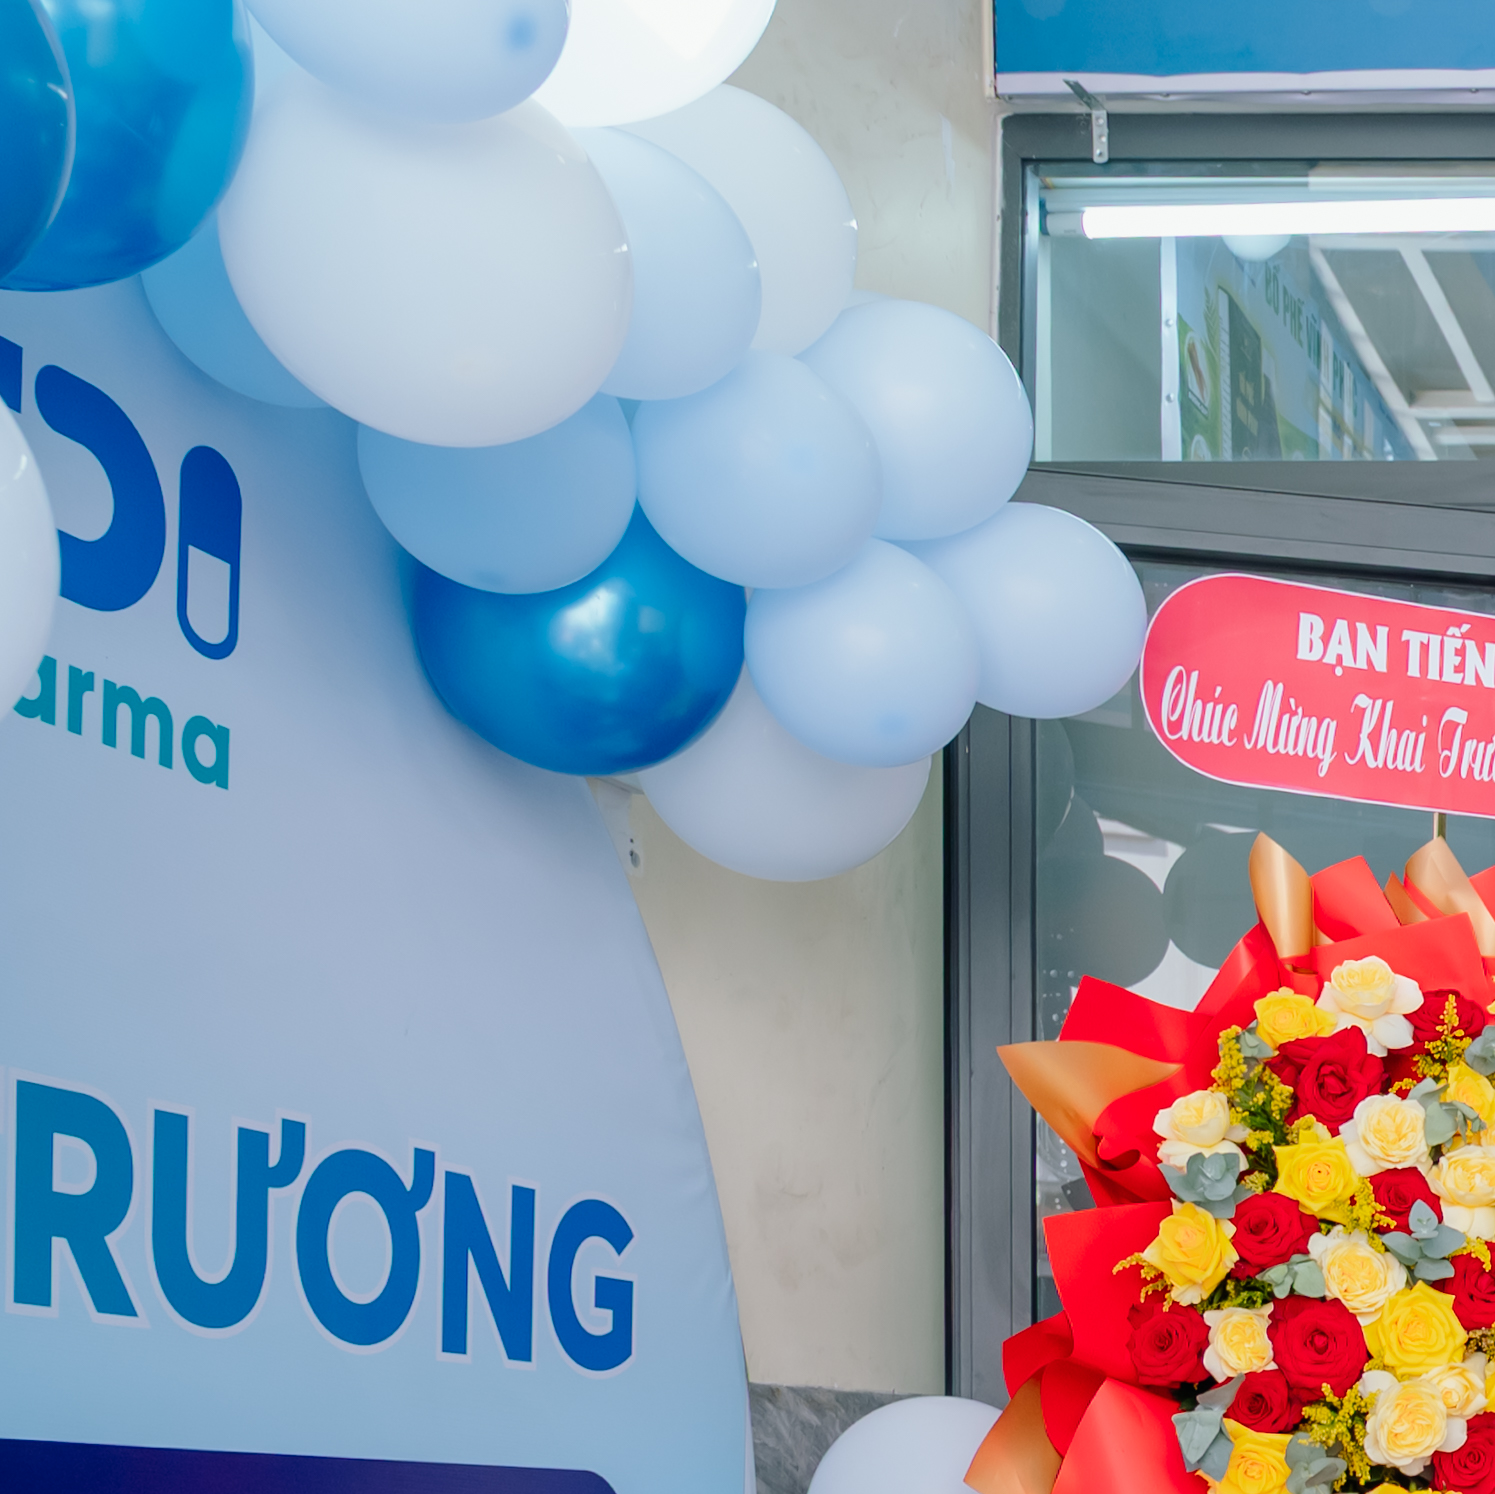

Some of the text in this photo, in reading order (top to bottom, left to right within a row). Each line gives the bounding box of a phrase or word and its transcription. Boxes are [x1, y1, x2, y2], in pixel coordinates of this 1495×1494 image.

[1297, 612, 1388, 677] BẠN
[12, 653, 231, 790] arma
[1160, 664, 1238, 748] Chúc
[1244, 680, 1338, 778] Mừng
[1344, 694, 1428, 774] Khai
[12, 1077, 636, 1373] RƯƠNG
